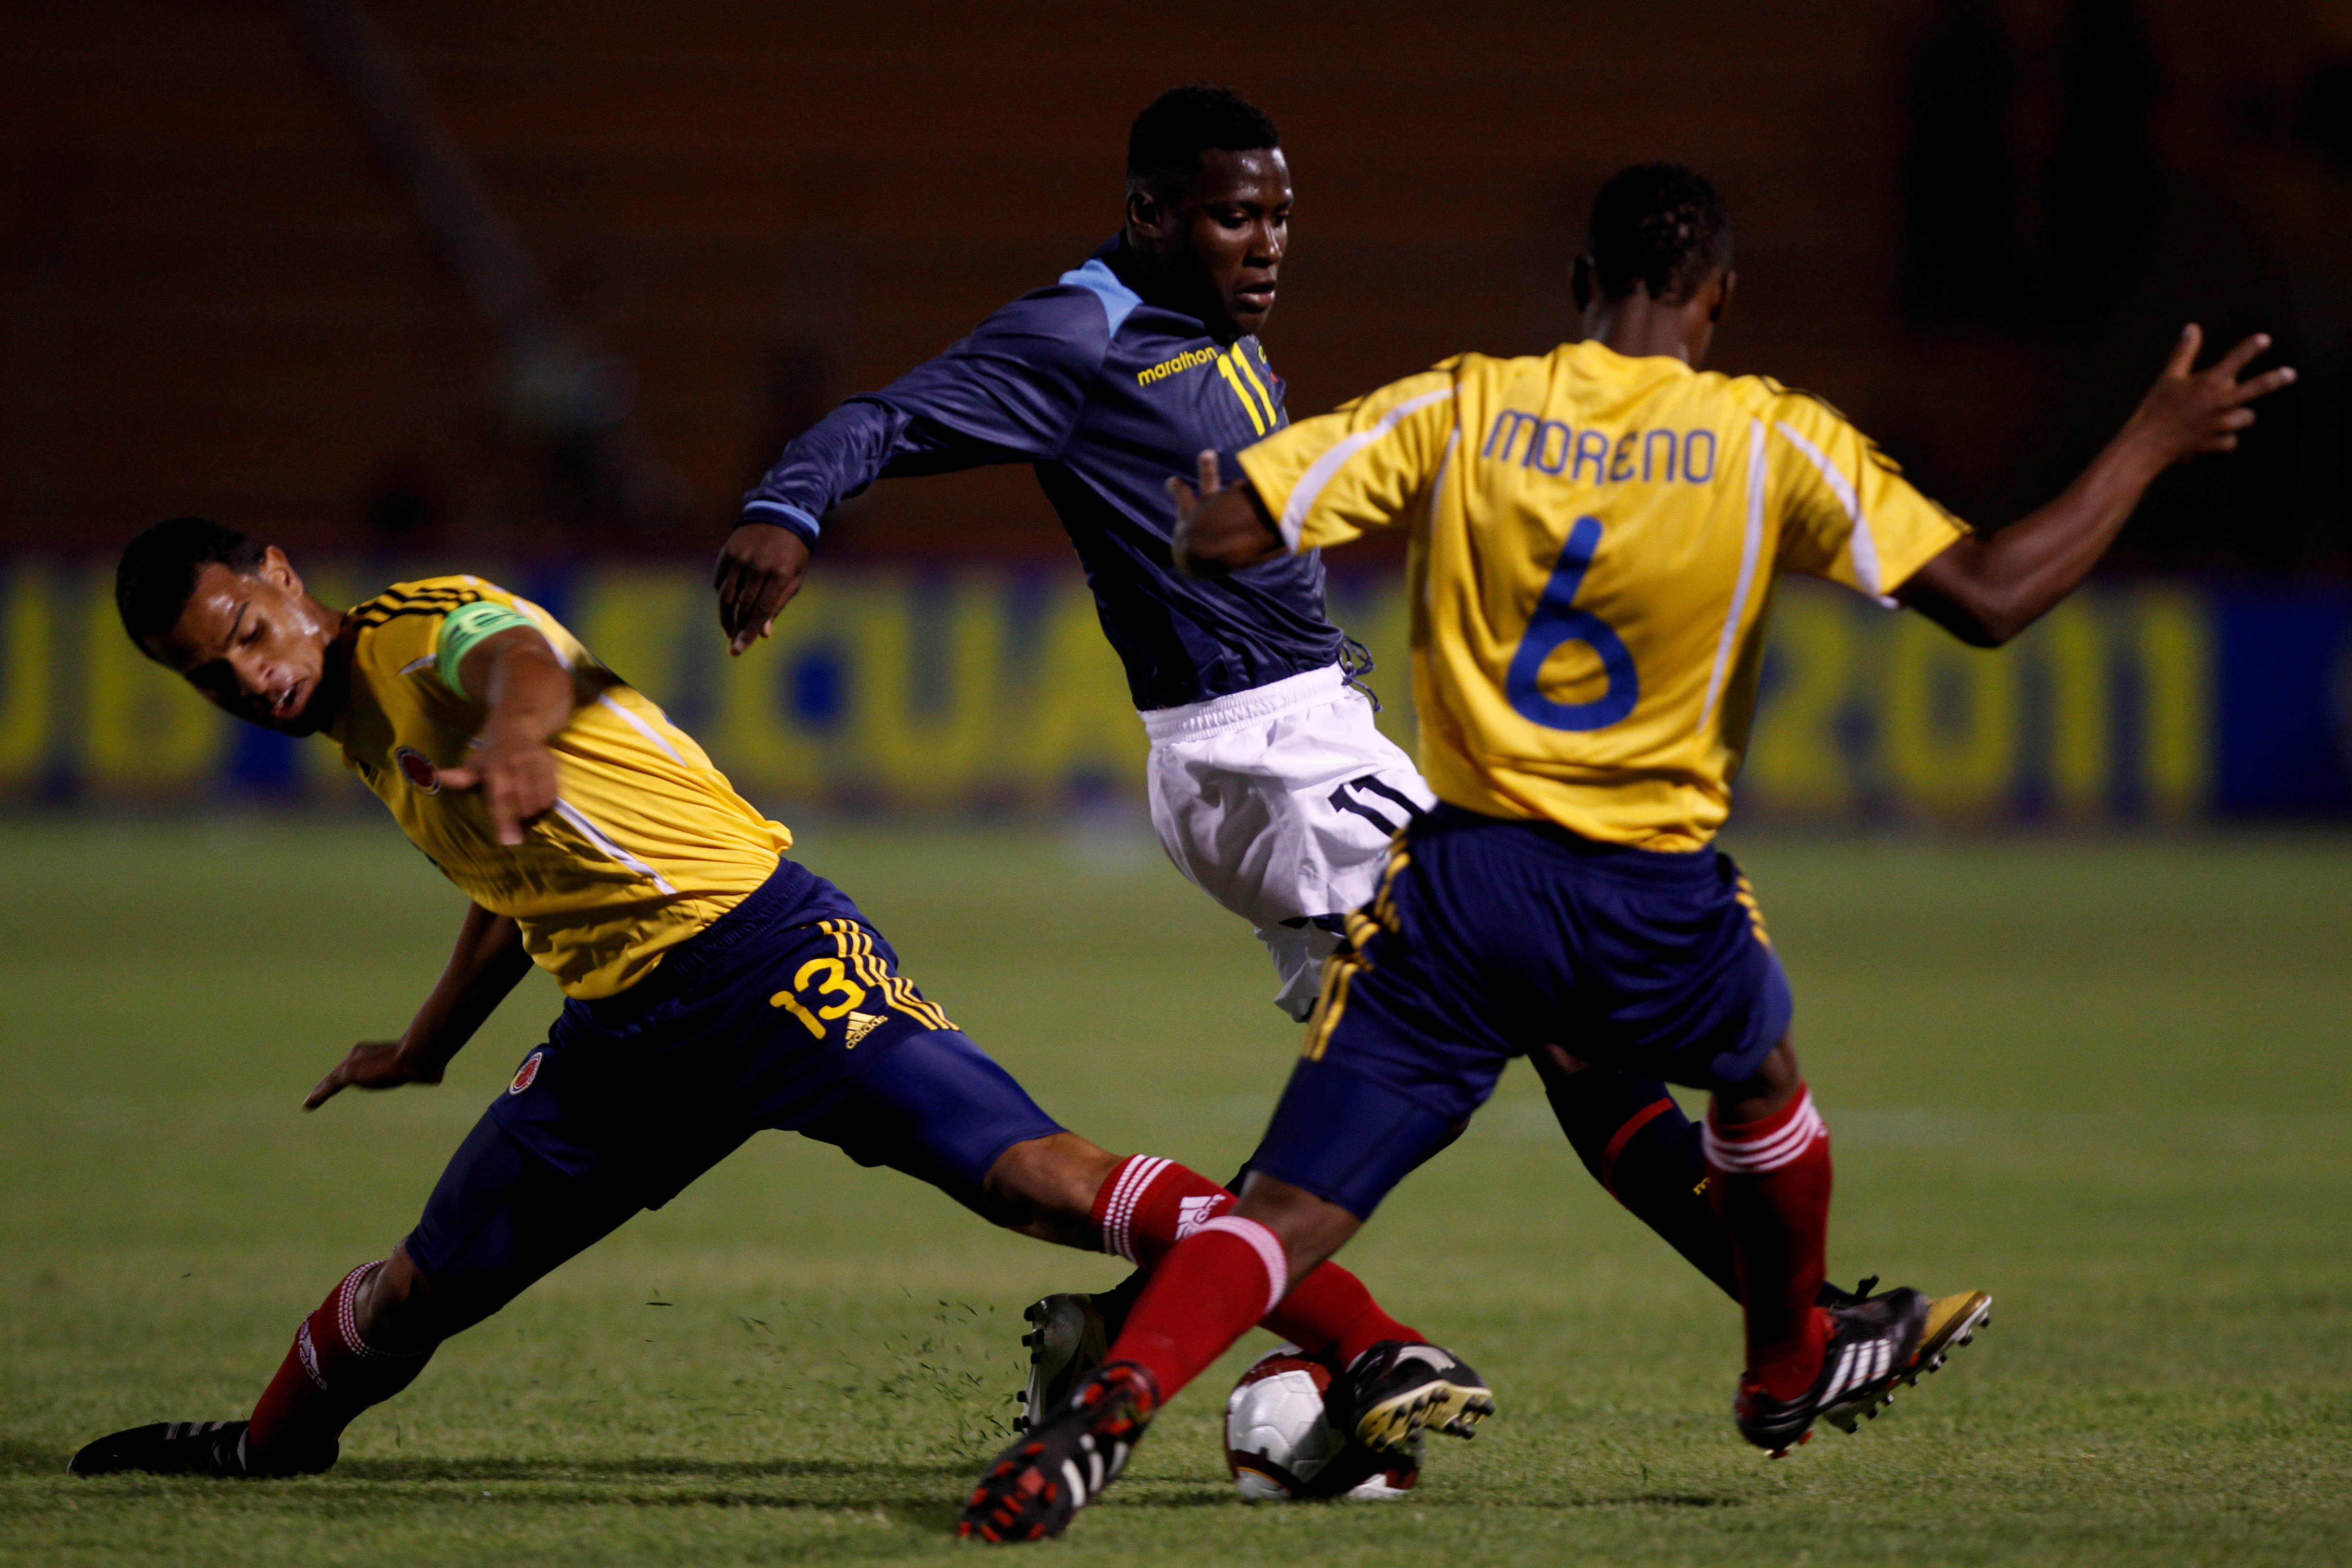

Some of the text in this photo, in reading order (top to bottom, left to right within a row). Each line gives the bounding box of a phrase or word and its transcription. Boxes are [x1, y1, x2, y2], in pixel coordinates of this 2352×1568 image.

[1137, 346, 1219, 387] marathon
[1217, 342, 1277, 436] 11
[1482, 409, 1716, 485] MORENO
[1505, 515, 1640, 731] 6
[1328, 775, 1426, 839] 11
[769, 957, 866, 1040] 13
[845, 1015, 889, 1050] adidas
